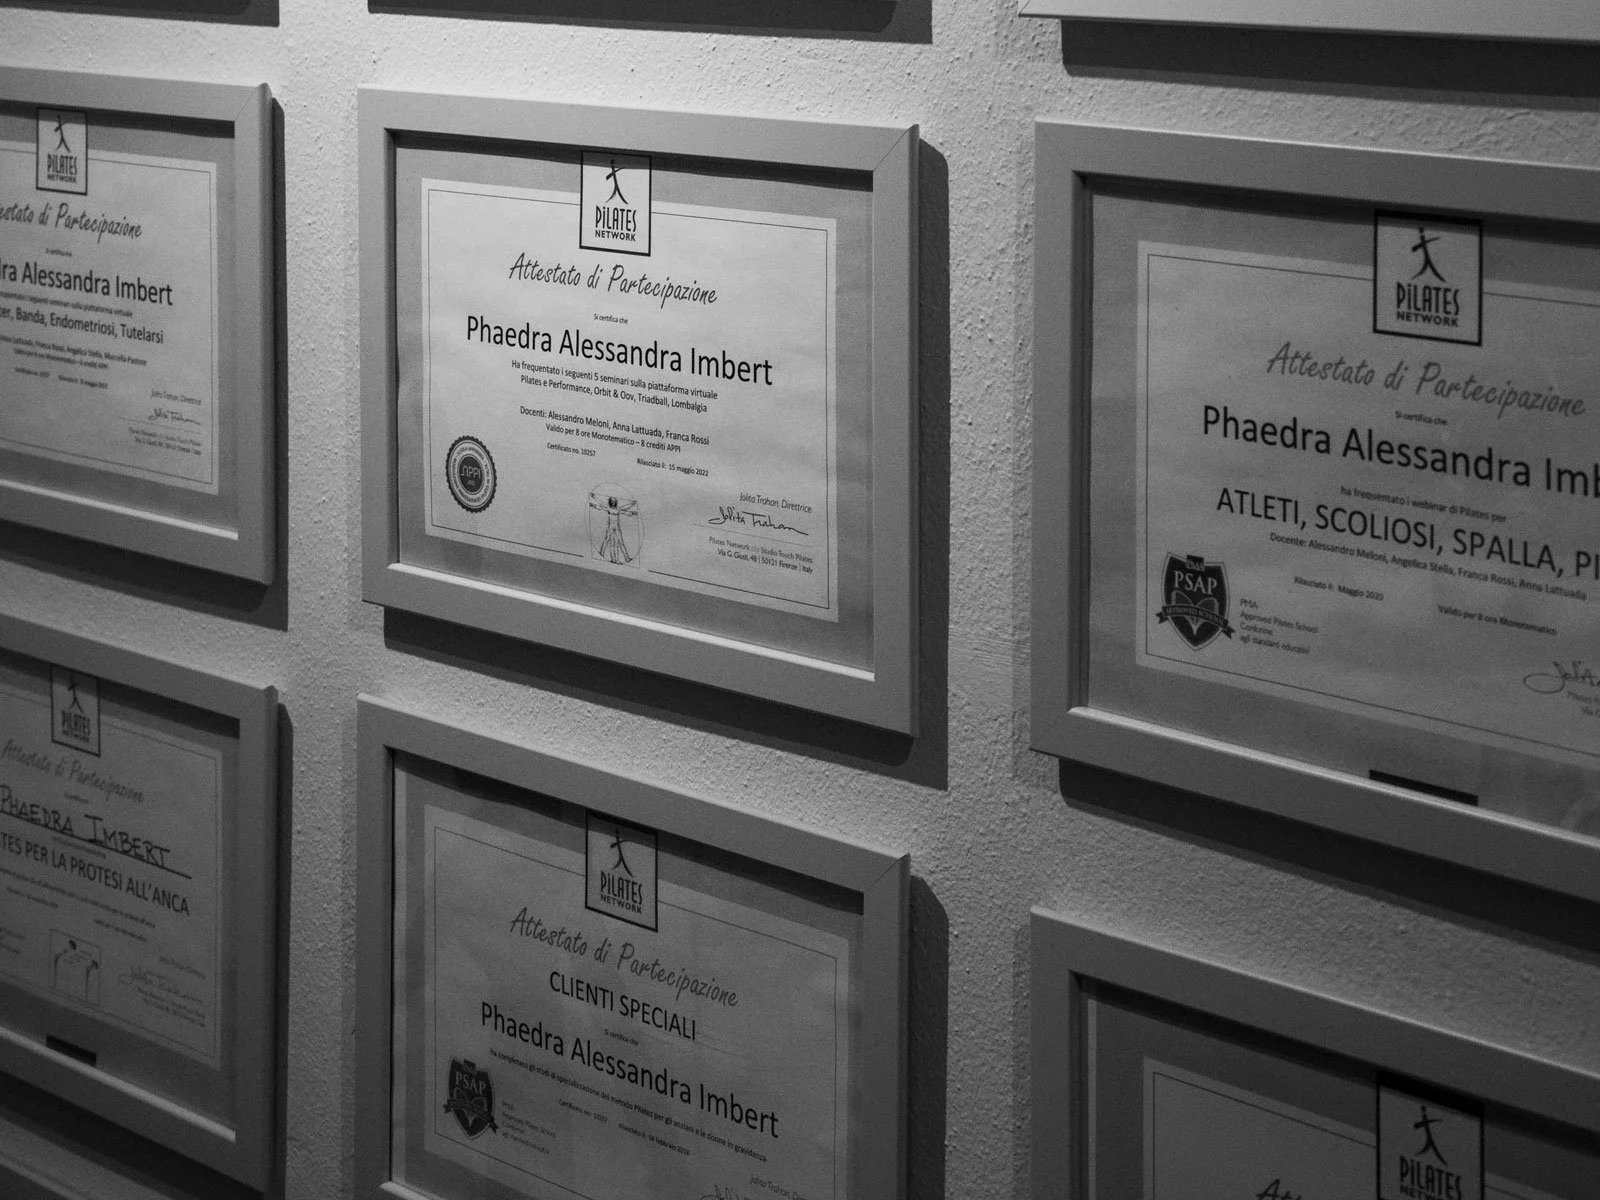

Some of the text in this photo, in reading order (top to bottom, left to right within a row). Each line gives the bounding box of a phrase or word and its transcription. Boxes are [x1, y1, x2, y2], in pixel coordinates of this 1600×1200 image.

[38, 201, 143, 244] di Partecipazione
[595, 230, 636, 242] NETWORK
[22, 260, 110, 296] Alessandra
[116, 275, 173, 306] Imbert
[508, 252, 718, 309] Attestato di Partecipazione
[16, 307, 164, 344] Banda, Endometriosi, Tutelarsi
[599, 314, 618, 324] certifica
[1395, 311, 1459, 328] NETWORK
[467, 315, 772, 385] Phaedra Alessandra Imbert
[512, 359, 718, 400] Ha frequentato seguenti seminari sulla piattaforma virtuale
[520, 375, 707, 414] Pilates Performance, Orbit Triadball, Lombalgia
[1266, 340, 1587, 420] Attestato di Partecipazione
[520, 406, 710, 446] Docenti: Alessandro Meloni, Anna Lattuada, Franca Rossi
[546, 423, 681, 453] Valido ore Monotematico crediti APPI
[1203, 404, 1331, 455] Phaedra
[1342, 427, 1531, 487] Alessandra
[695, 468, 708, 477] 2022
[781, 499, 812, 513] Direttrice
[1216, 487, 1564, 579] ATLETI, SCOLIOSI, SPALLA,
[1308, 539, 1354, 556] Alessandro
[1174, 571, 1217, 595] PSAP
[0, 784, 73, 834] PHAEDRA
[84, 814, 171, 868] IMBERT
[25, 841, 49, 865] PER
[52, 852, 67, 871] LA
[70, 857, 123, 891] PROTESI
[125, 876, 190, 917] ALL'ANCA
[600, 894, 642, 915] NETWORK
[510, 906, 739, 1006] Attestato di Partecipazione
[550, 971, 695, 1041] CLIENTI SPECIALI
[481, 1001, 779, 1139] Phaedra Alessandra Imbert
